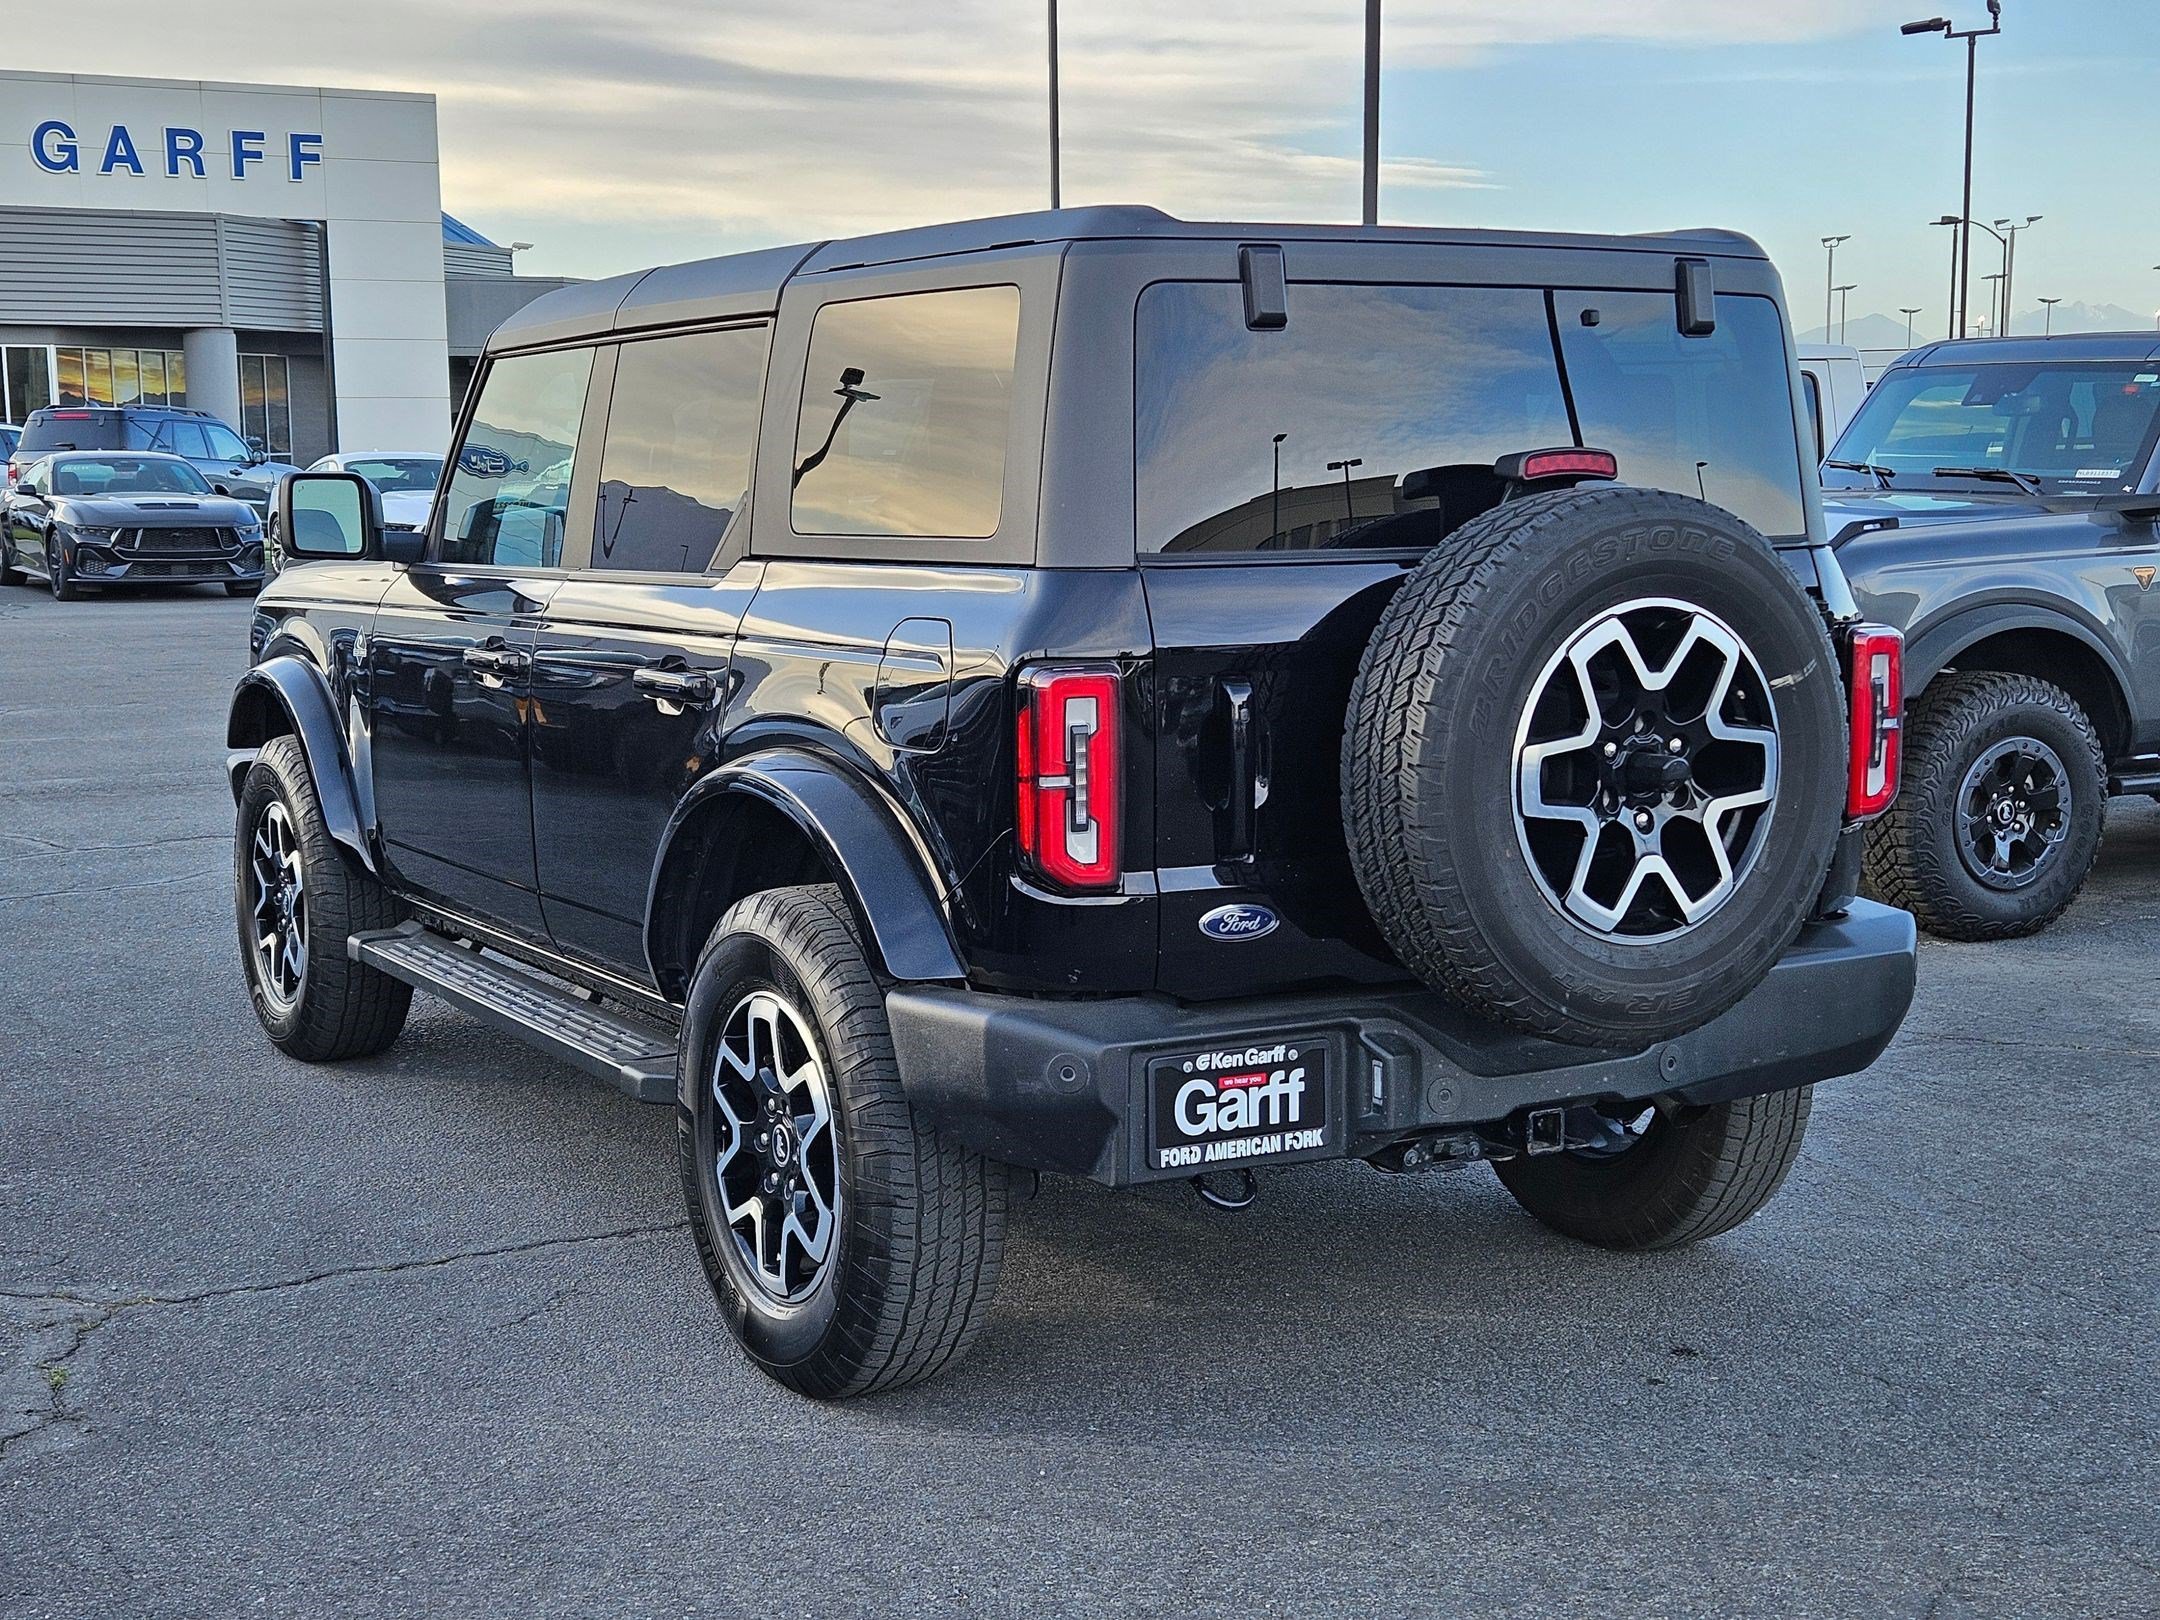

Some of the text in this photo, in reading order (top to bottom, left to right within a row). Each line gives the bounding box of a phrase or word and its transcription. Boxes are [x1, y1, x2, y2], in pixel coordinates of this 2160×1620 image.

[29, 118, 324, 183] GARFF
[1469, 525, 1737, 741] BRIDGESTONE
[1219, 912, 1261, 933] Ford
[1210, 1044, 1286, 1070] Ken Garff
[1234, 1077, 1248, 1085] hear
[1249, 1076, 1262, 1085] you
[1174, 1067, 1305, 1137] Garff
[1160, 1128, 1324, 1168] FORD AMERICAN FORK
